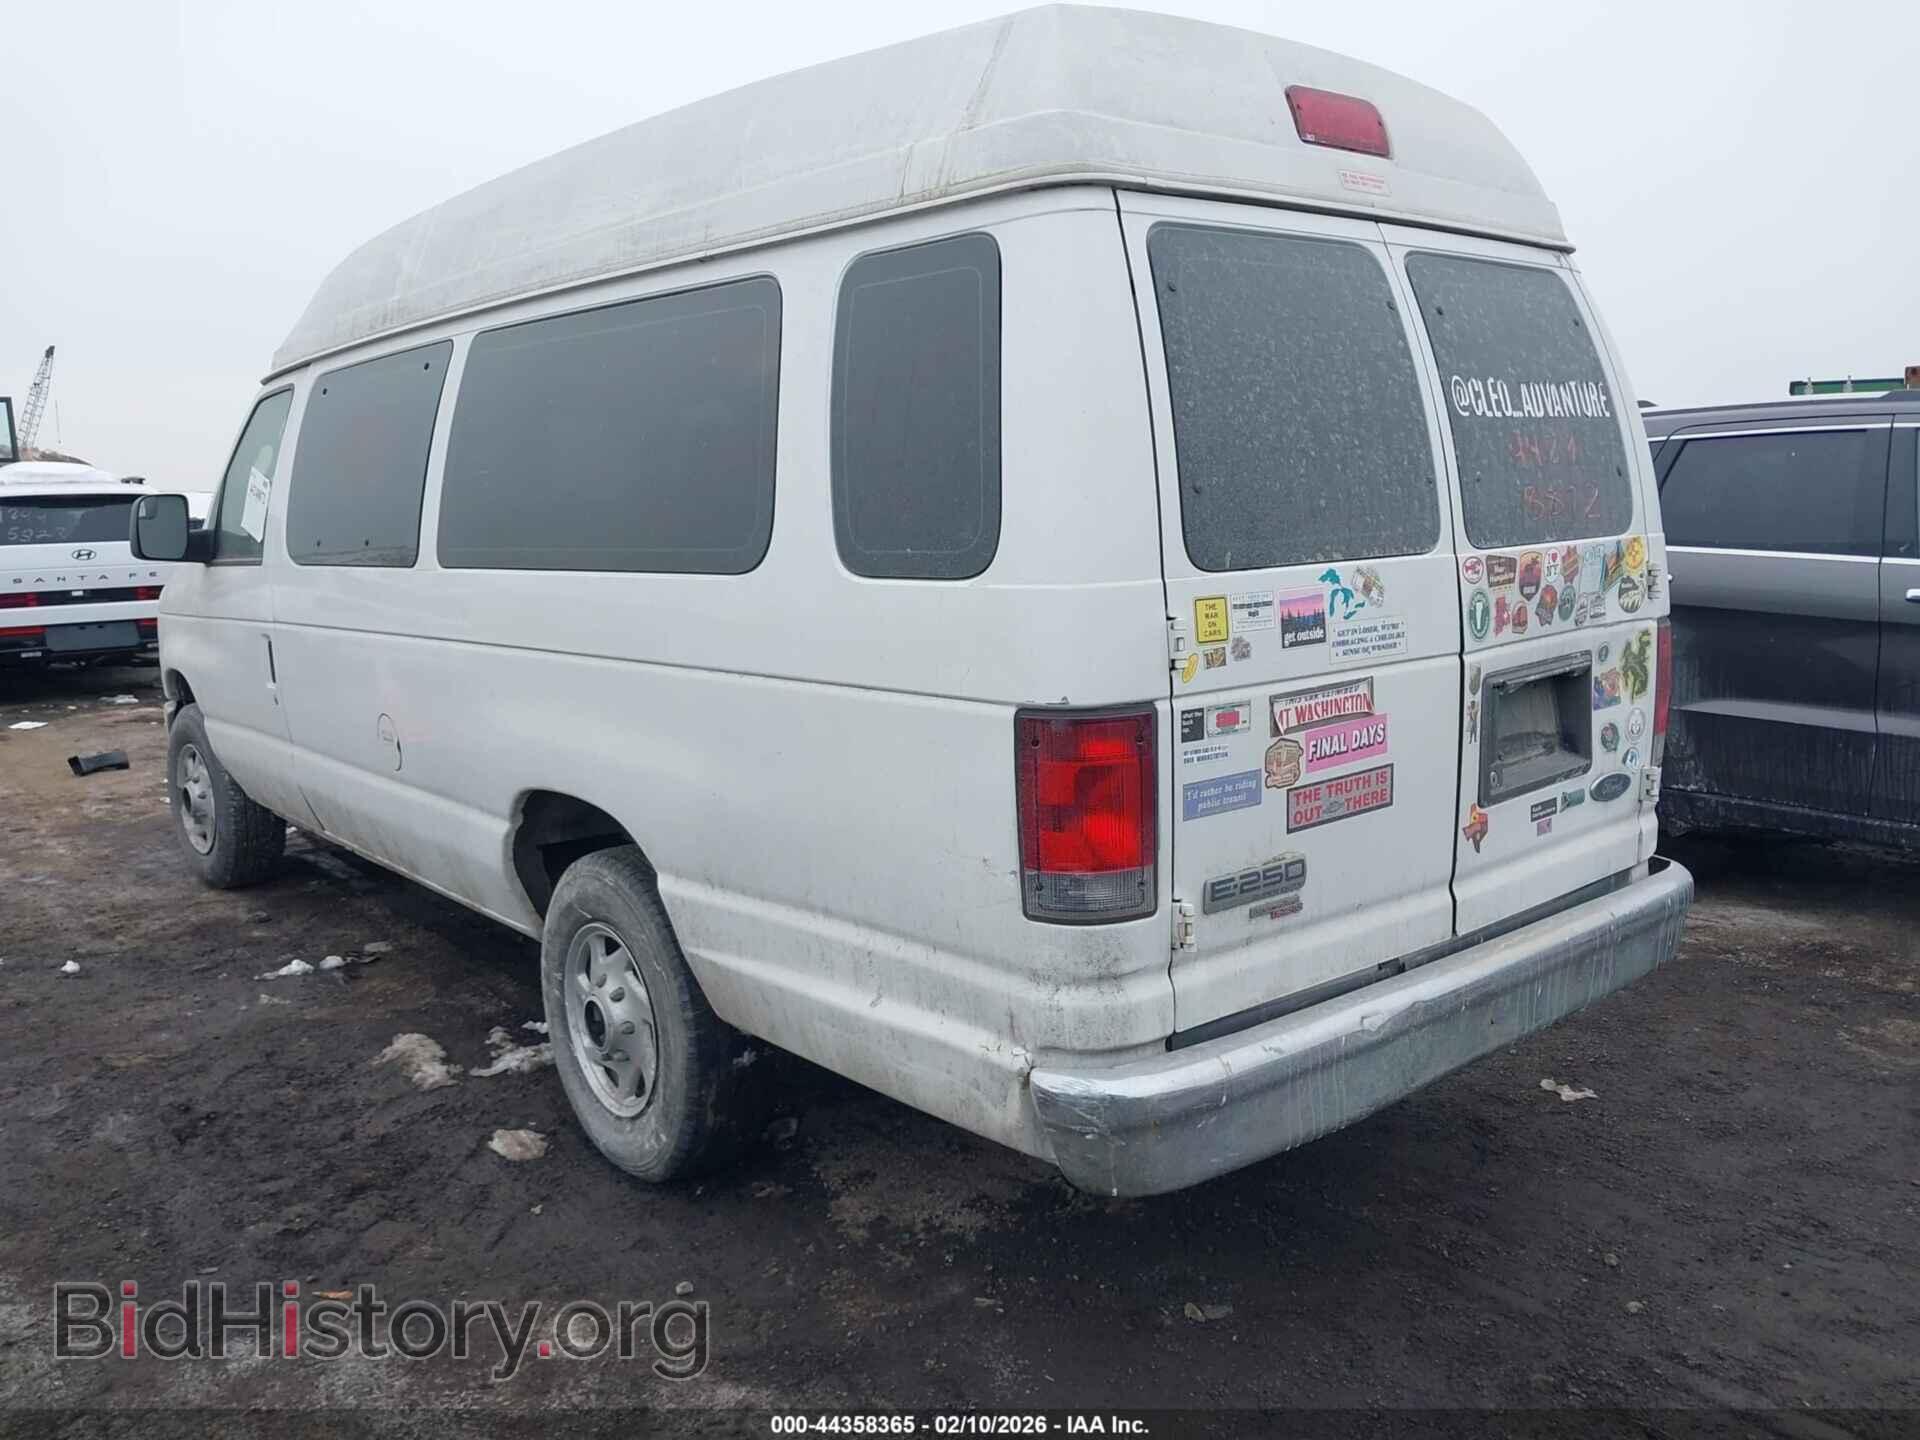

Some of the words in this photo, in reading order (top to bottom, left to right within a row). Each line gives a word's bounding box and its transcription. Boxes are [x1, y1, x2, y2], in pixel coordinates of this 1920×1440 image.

[13, 573, 109, 584] SANTA
[128, 571, 158, 579] FE
[1204, 602, 1218, 610] THE
[1284, 632, 1297, 648] get
[1297, 626, 1325, 642] outside
[1308, 733, 1348, 763] FINAL
[1351, 723, 1387, 752] DAYS
[1294, 786, 1322, 807] THE
[1325, 774, 1372, 798] TRUTH
[1375, 770, 1388, 786] IS
[1293, 804, 1323, 826] OUT
[1344, 788, 1388, 812] THERE
